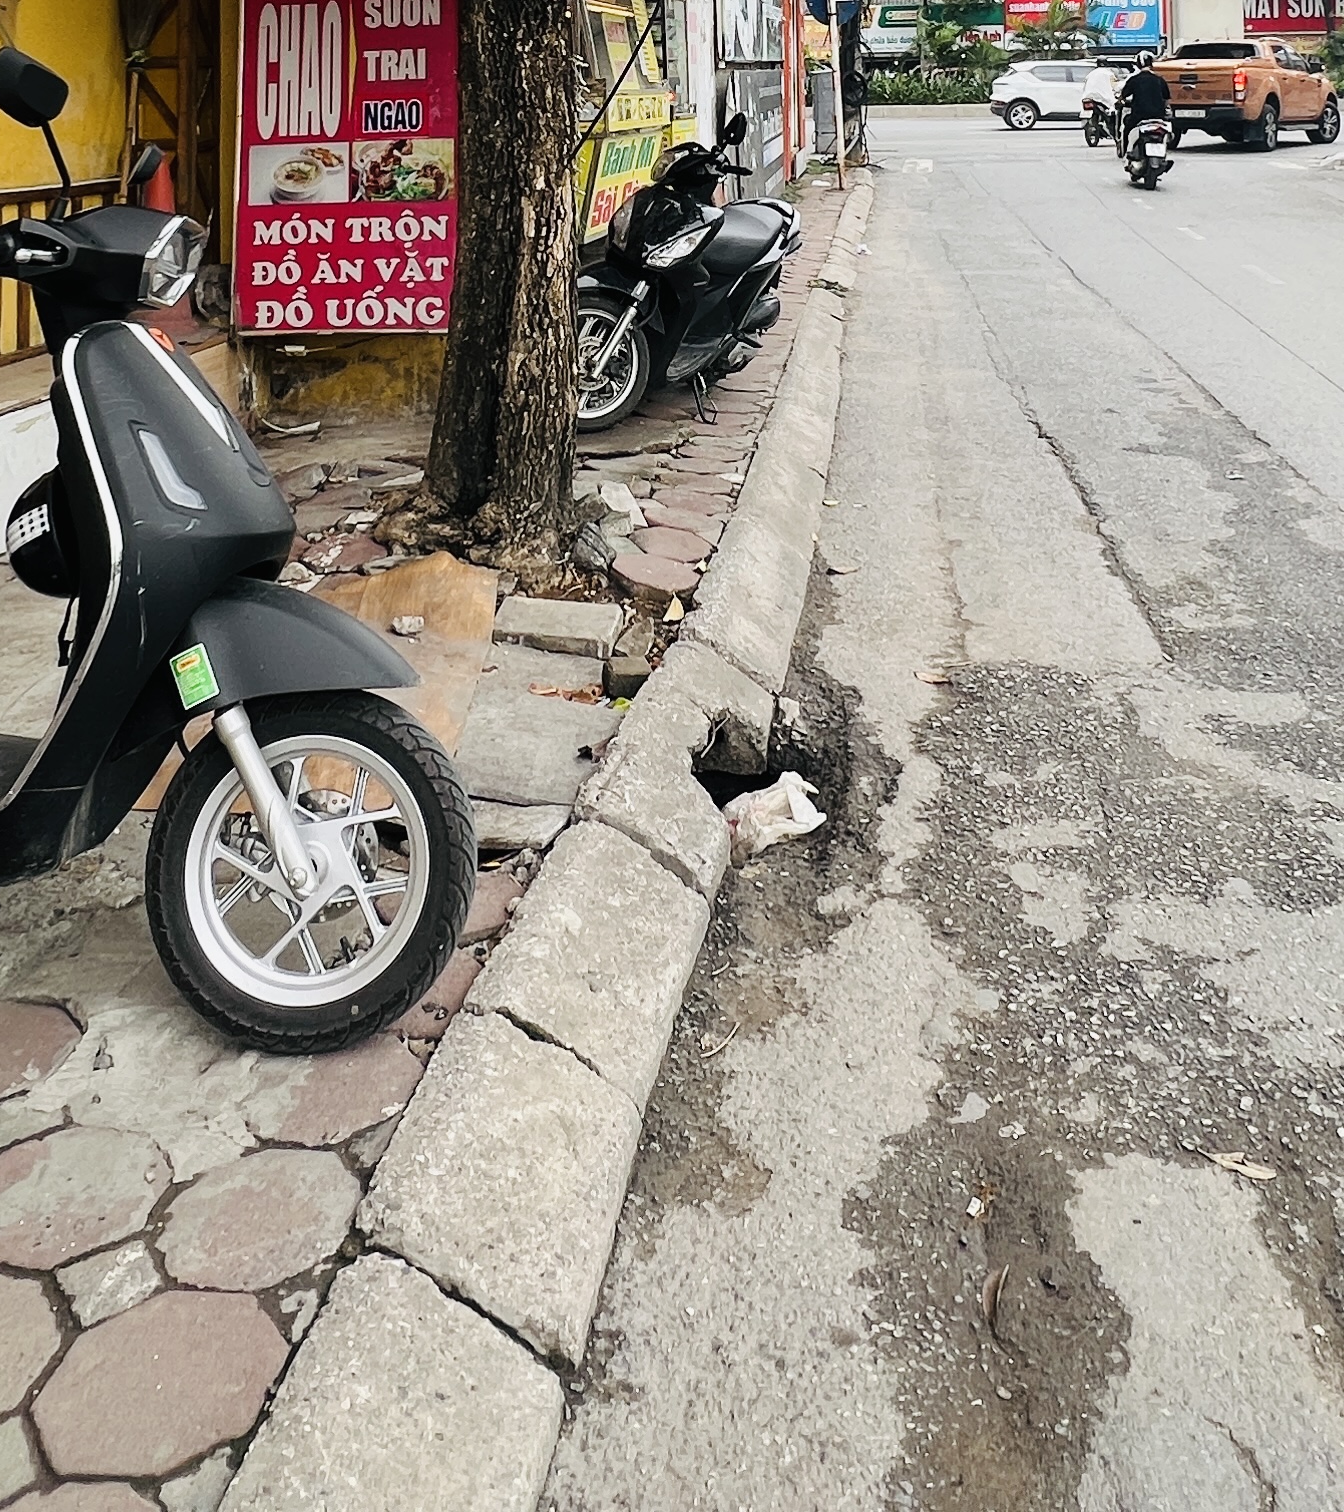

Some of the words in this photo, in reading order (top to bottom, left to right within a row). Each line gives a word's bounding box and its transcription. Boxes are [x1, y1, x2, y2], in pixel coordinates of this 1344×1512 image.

[1099, 11, 1146, 30] LED
[363, 47, 427, 82] TRAI
[363, 100, 423, 133] NGAO
[601, 139, 637, 178] Bánh
[252, 212, 335, 245] MÓN
[345, 209, 450, 249] TRỘN
[252, 249, 302, 286] ĐỒ
[311, 253, 365, 285] ĂN
[373, 253, 450, 290] VẶT
[255, 286, 313, 329] ĐỒ
[326, 285, 446, 328] UỐNG
